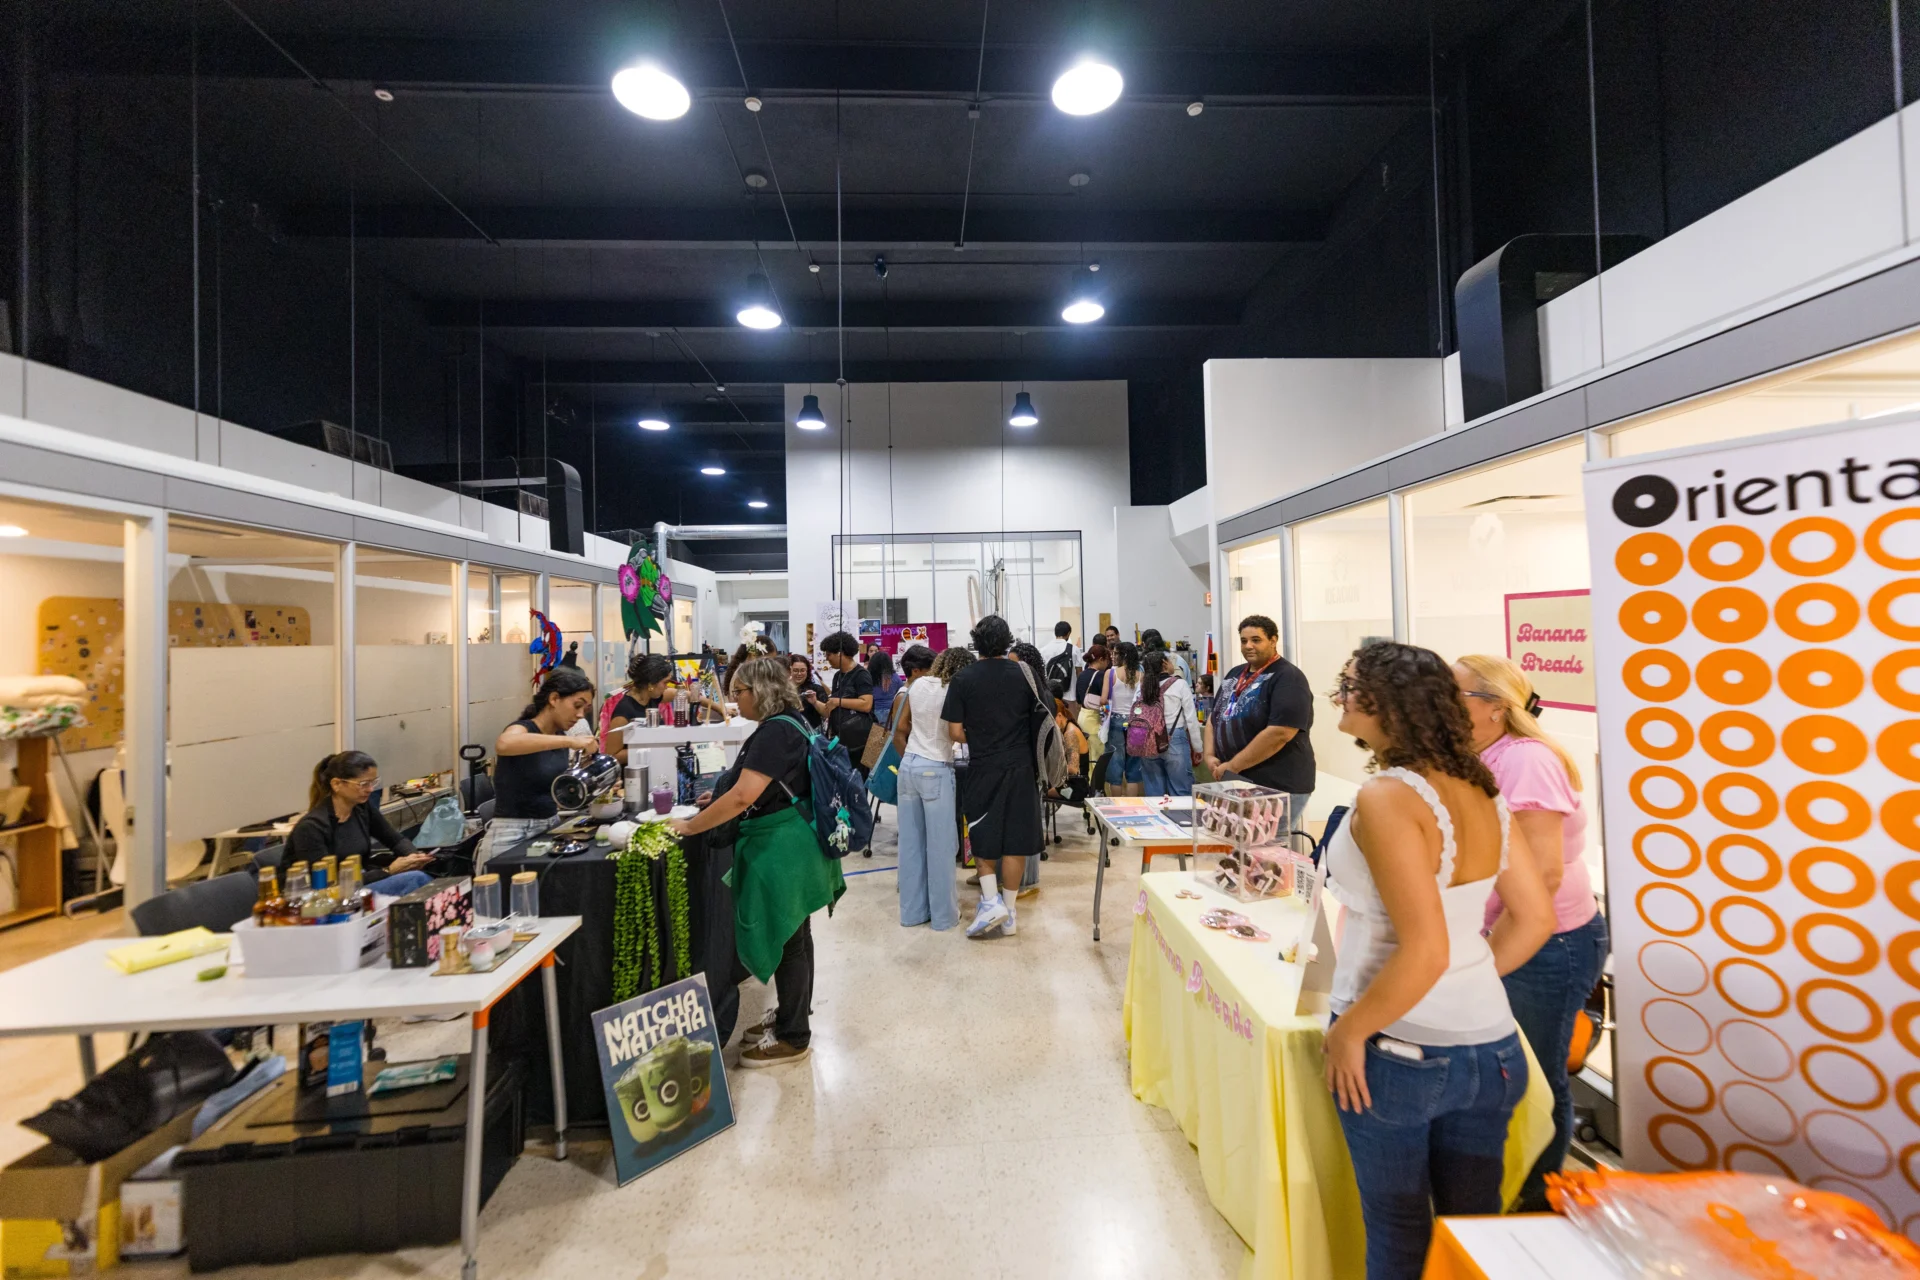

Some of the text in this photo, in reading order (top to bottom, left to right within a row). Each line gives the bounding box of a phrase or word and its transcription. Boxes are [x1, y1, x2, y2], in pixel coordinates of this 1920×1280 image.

[1516, 623, 1587, 643] Banana
[1520, 652, 1584, 674] Breads
[1133, 889, 1183, 975] Banana
[603, 988, 700, 1045] NATCHA
[608, 1006, 707, 1067] MATCHA
